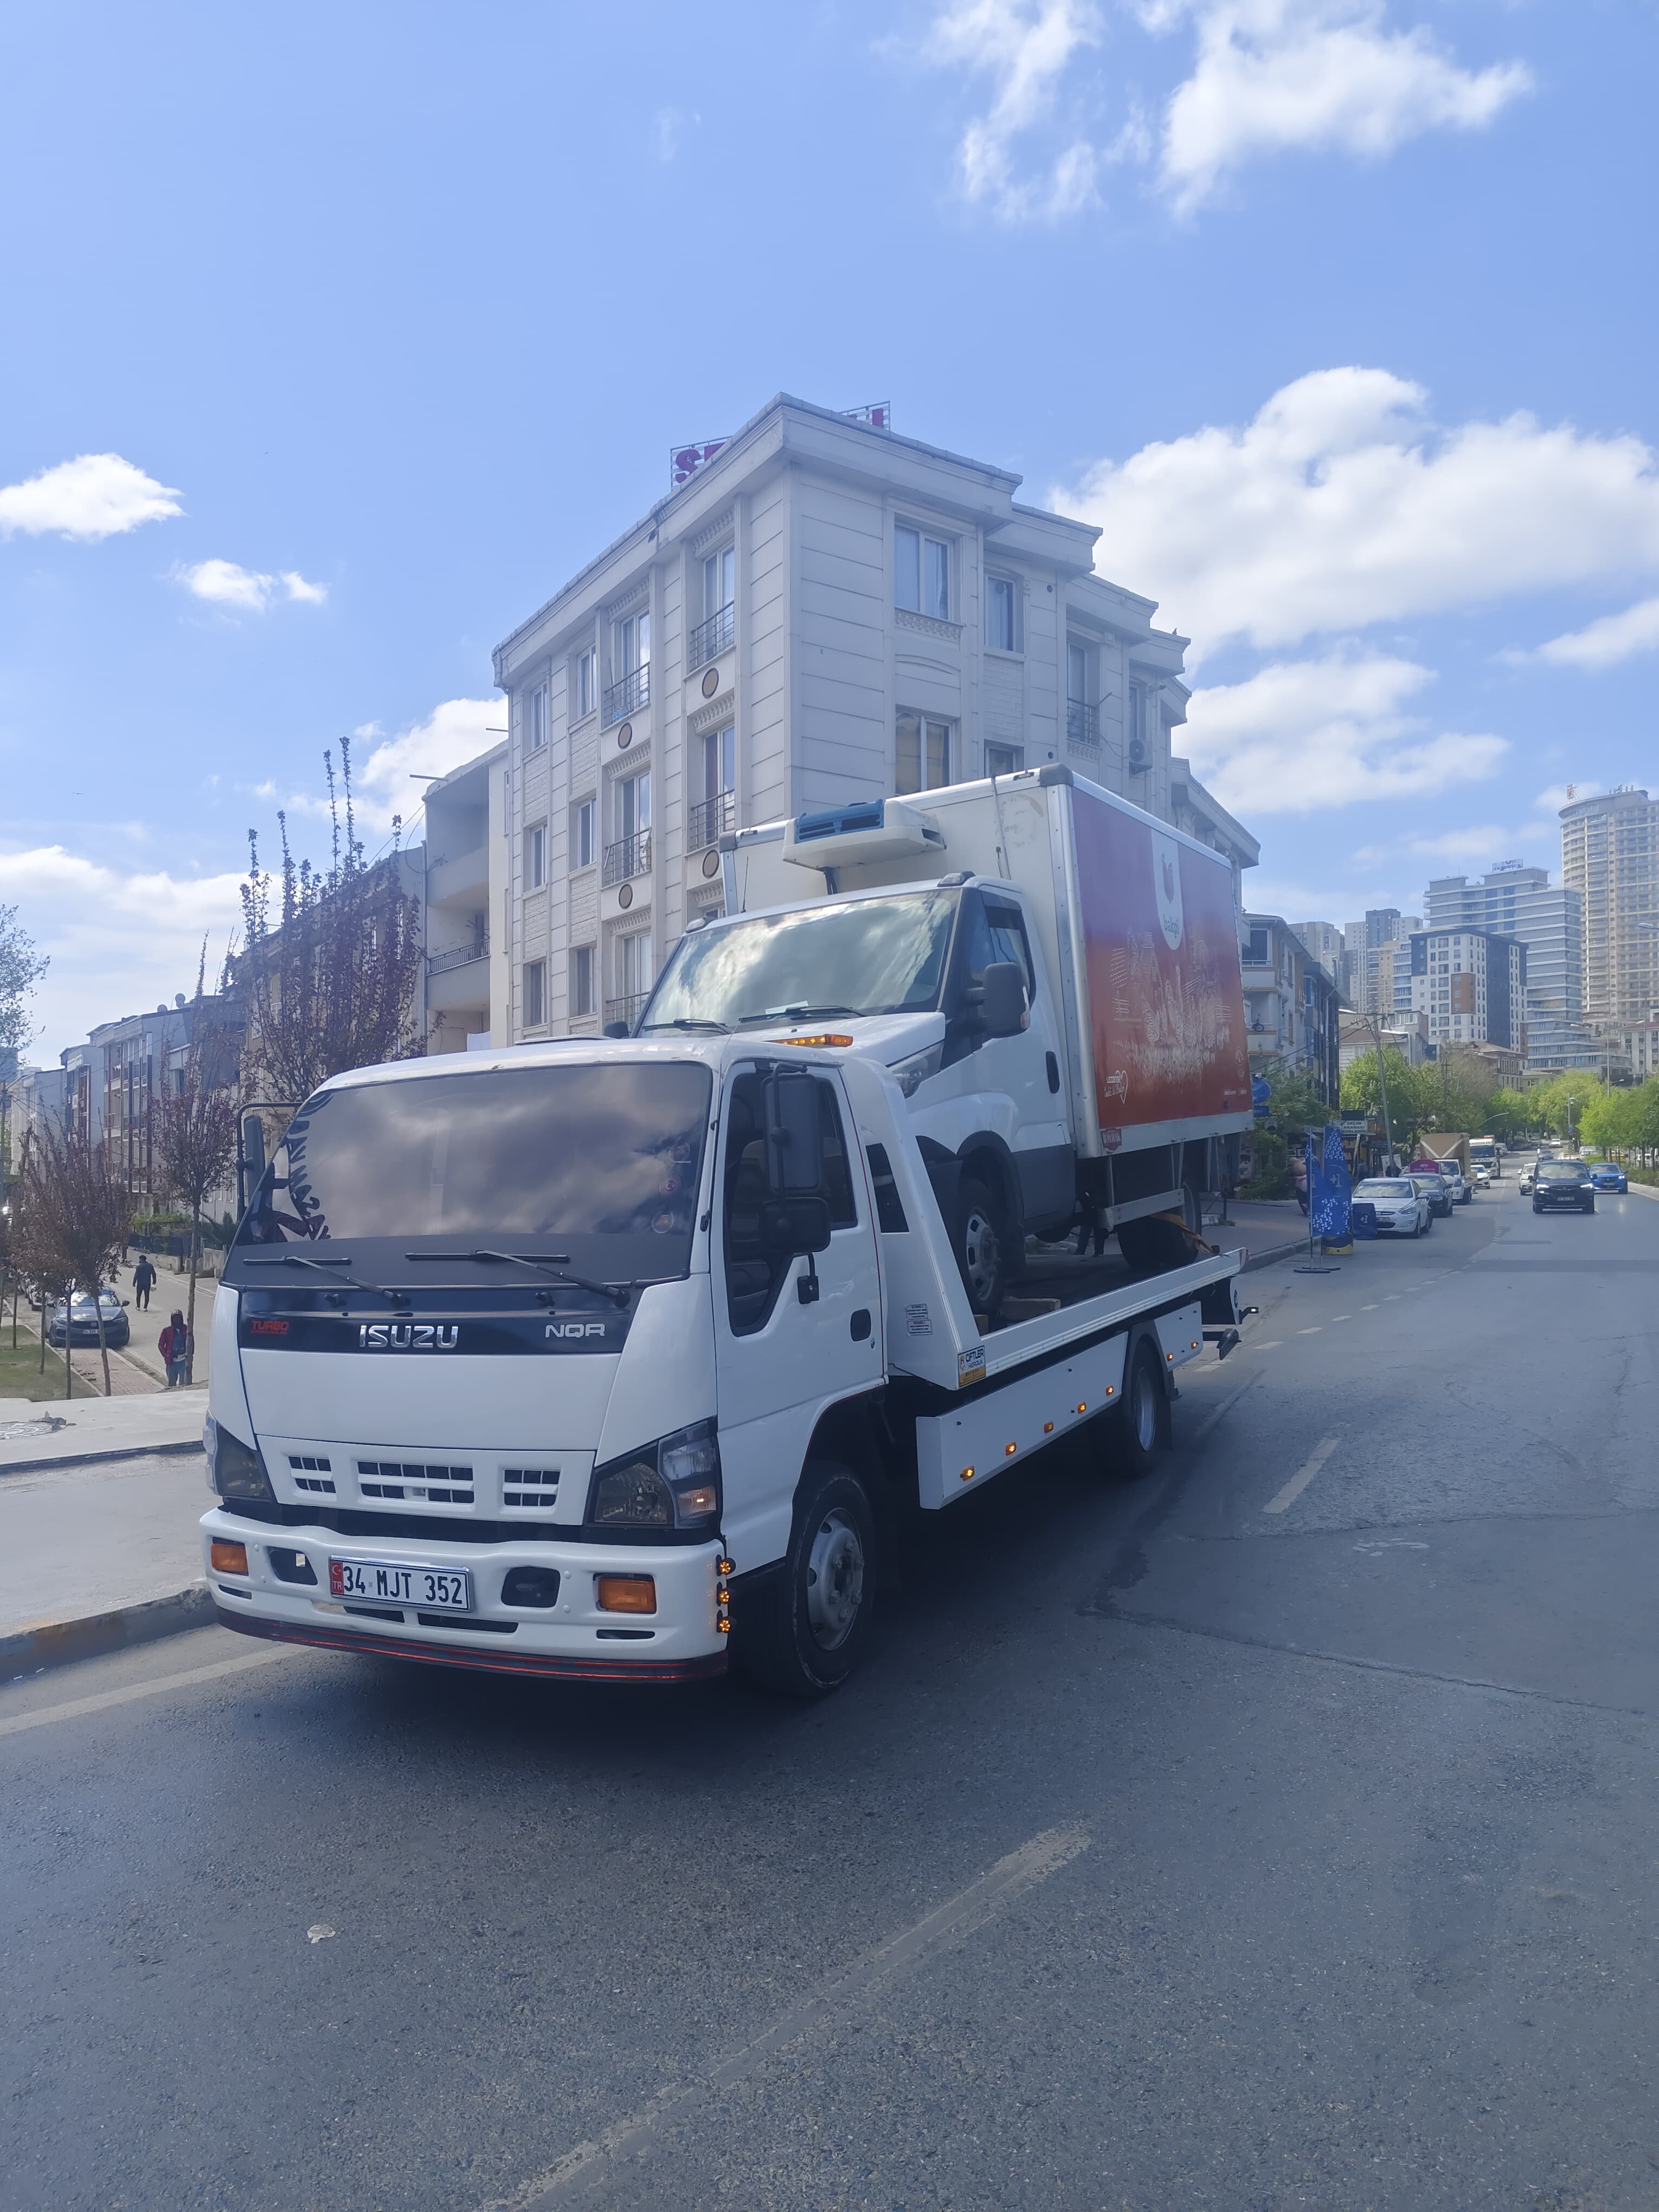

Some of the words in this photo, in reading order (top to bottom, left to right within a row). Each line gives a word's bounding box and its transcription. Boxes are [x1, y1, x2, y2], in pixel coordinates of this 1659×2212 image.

[1163, 914, 1180, 938] bakpi
[1330, 1173, 1342, 1188] +1
[1360, 1214, 1368, 1224] +1
[252, 1321, 290, 1331] TURBO
[545, 1323, 606, 1338] NQR
[359, 1325, 459, 1348] ISUZU
[332, 1580, 342, 1591] TR
[343, 1566, 366, 1594] 34
[376, 1570, 411, 1599] MJT
[424, 1574, 462, 1604] 352
